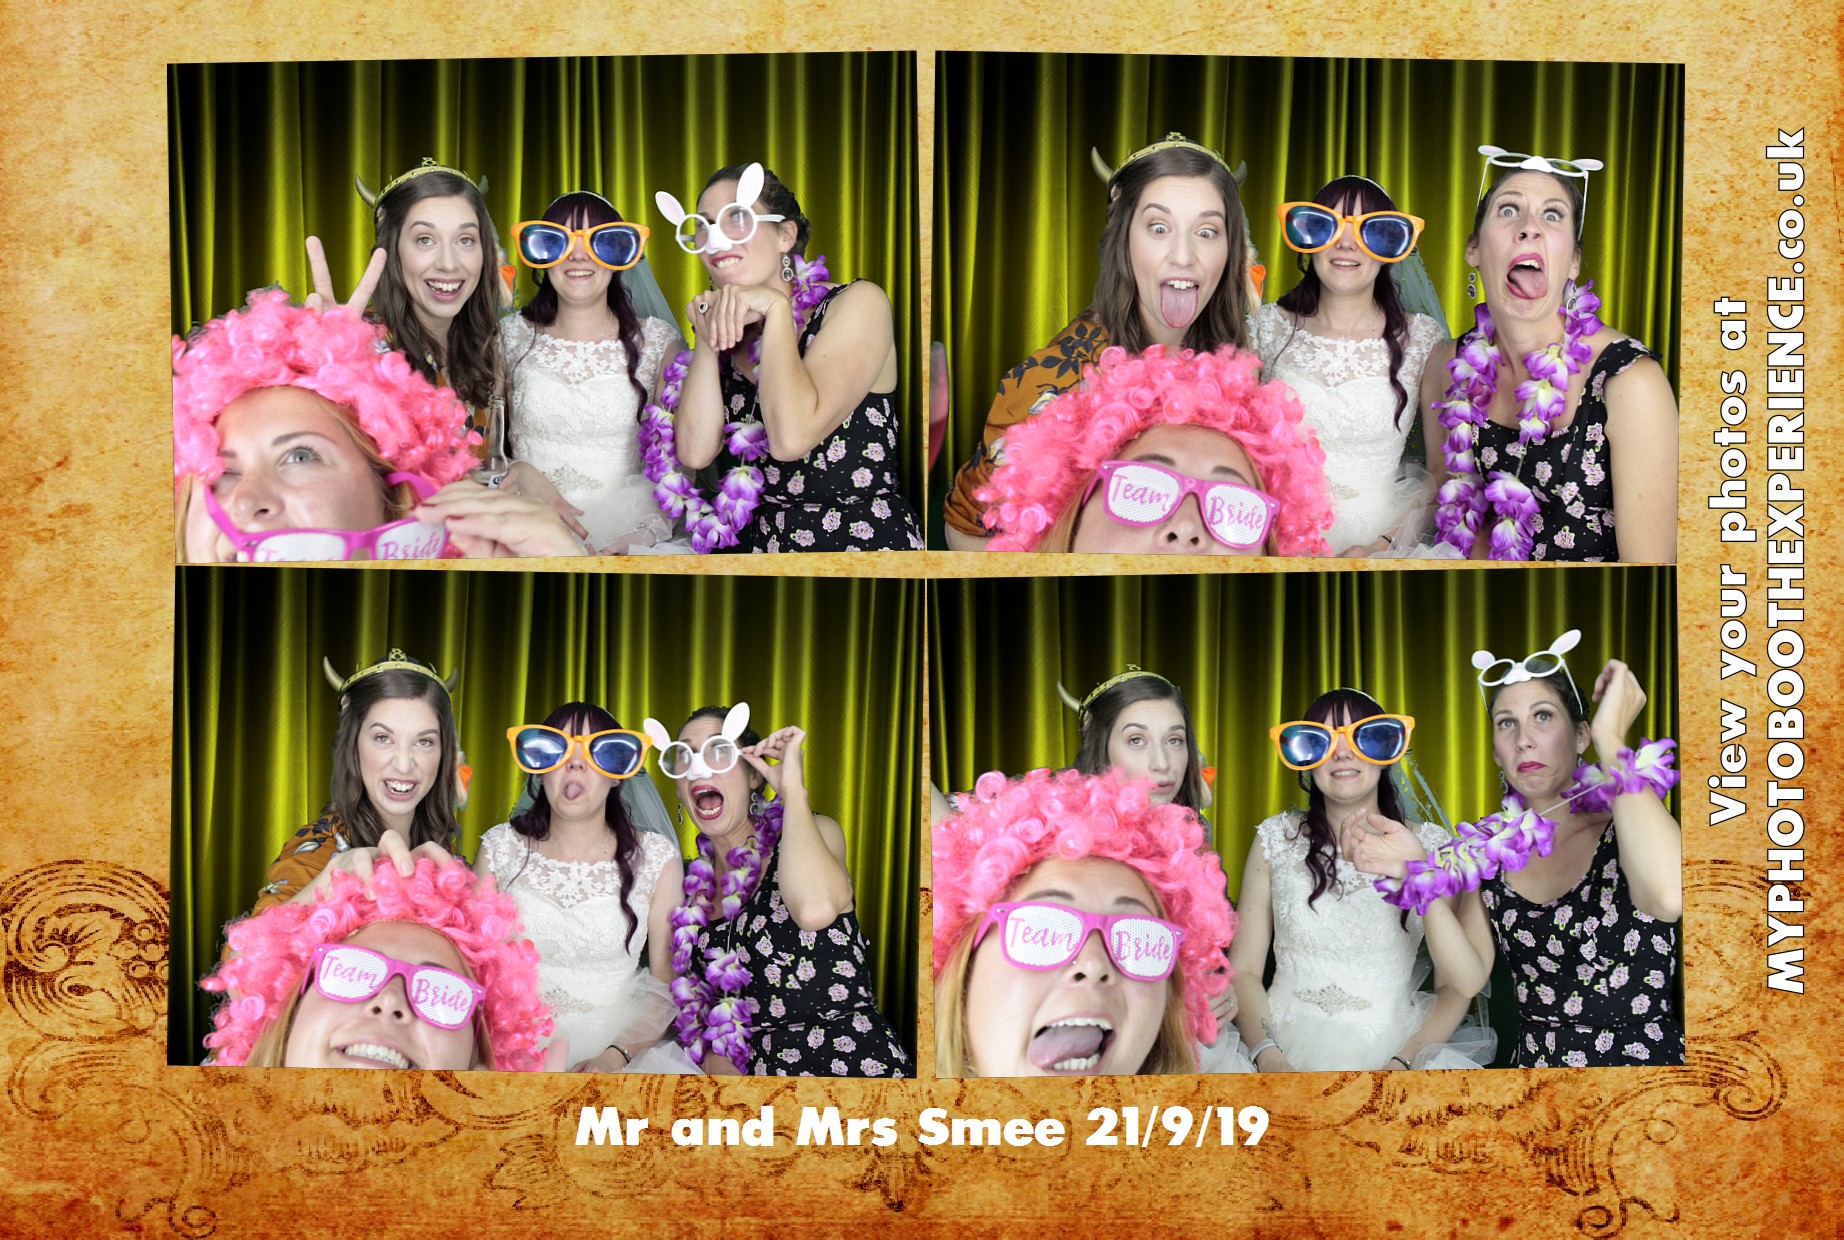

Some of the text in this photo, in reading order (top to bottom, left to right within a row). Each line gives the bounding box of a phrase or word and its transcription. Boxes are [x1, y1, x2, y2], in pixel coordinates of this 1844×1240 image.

[1112, 474, 1264, 530] Team Bride
[1010, 917, 1171, 961] Team Bride
[322, 955, 468, 1012] Team Bride
